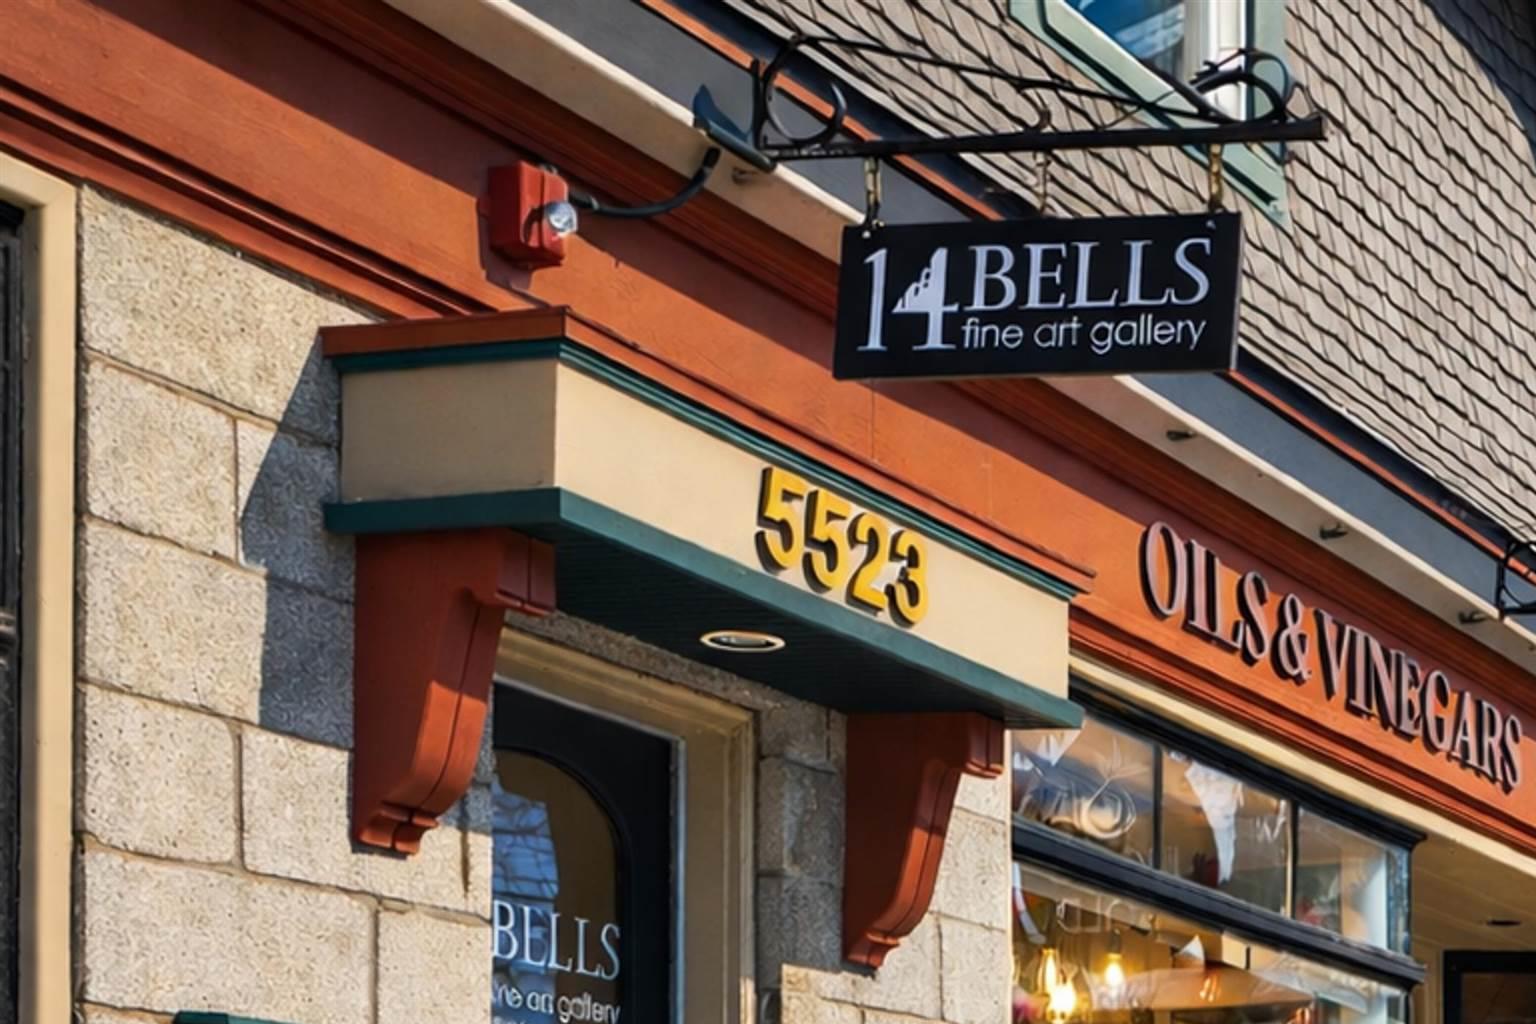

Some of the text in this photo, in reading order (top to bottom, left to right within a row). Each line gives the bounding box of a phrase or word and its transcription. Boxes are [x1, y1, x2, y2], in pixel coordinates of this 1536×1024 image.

[857, 237, 1213, 352] 14 BELLS
[960, 313, 1207, 355] fine art gallery
[755, 465, 929, 629] 5523
[492, 899, 621, 981] BELLS
